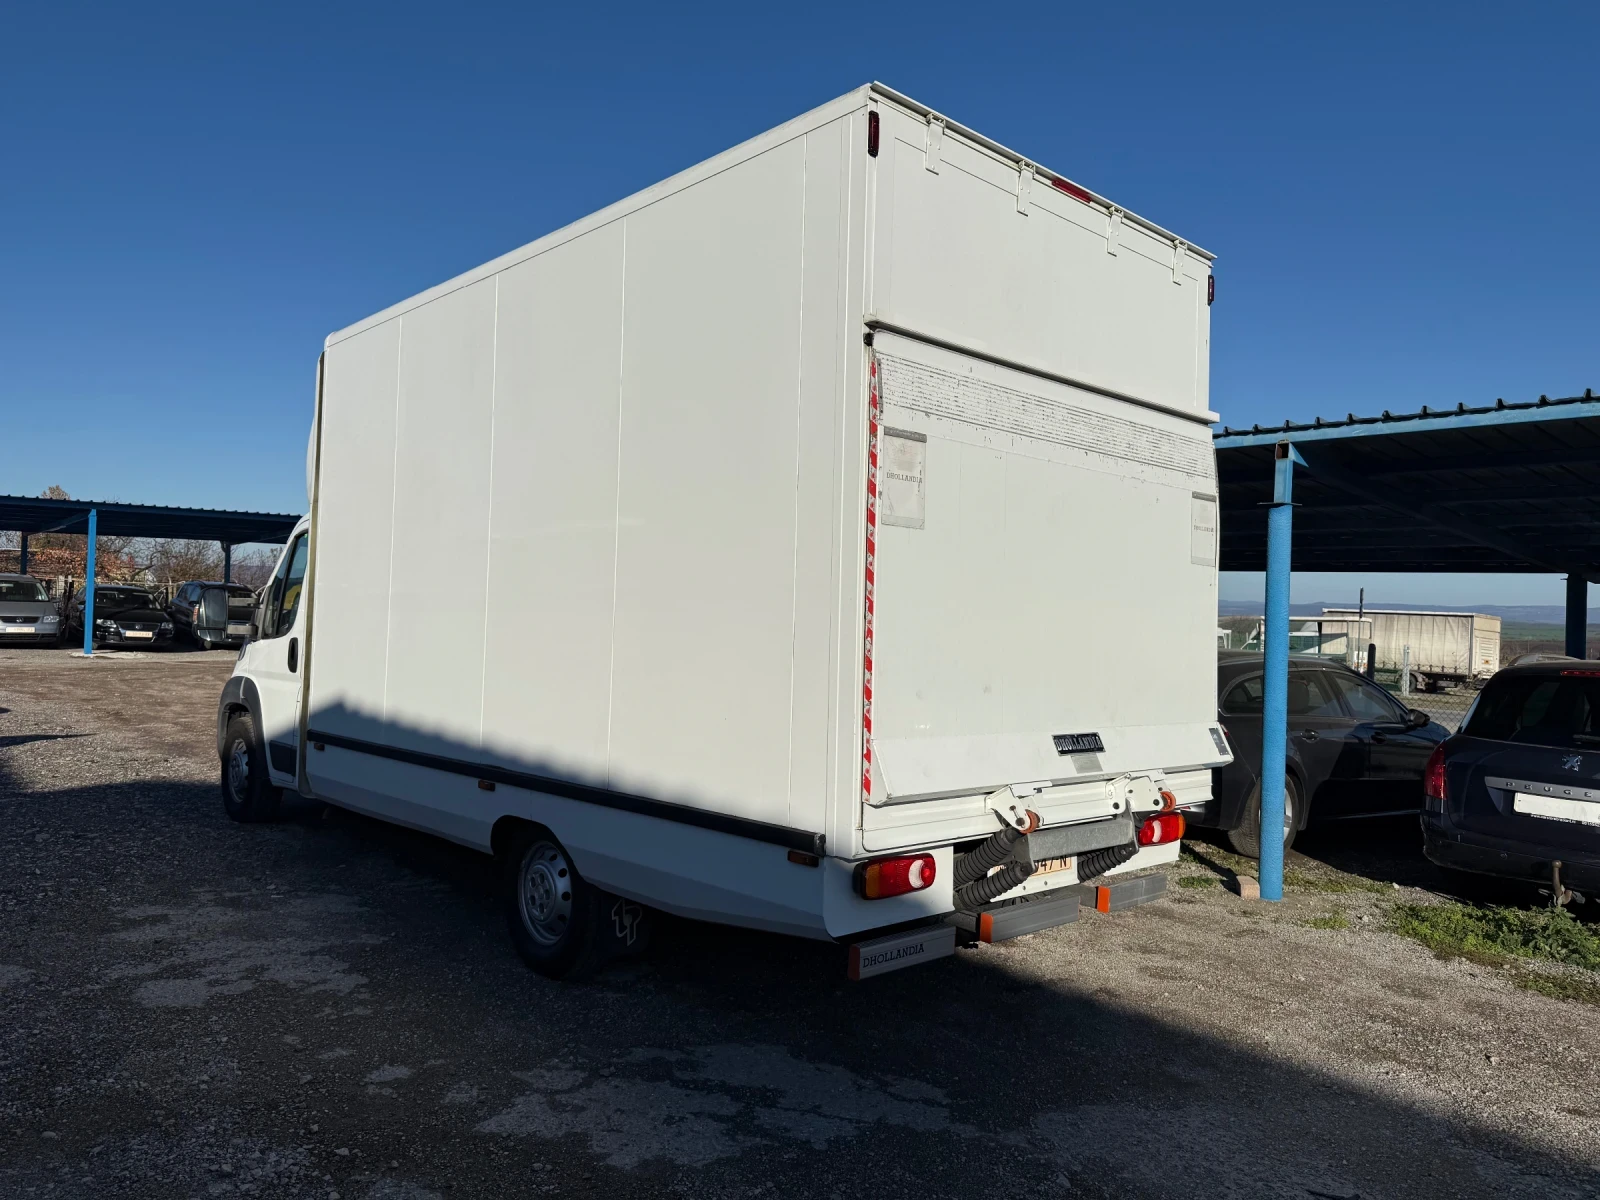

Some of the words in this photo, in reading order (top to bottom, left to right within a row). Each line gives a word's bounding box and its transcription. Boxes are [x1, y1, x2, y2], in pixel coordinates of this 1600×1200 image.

[886, 471, 923, 484] DHOLLANDIA
[1055, 736, 1103, 751] DHOLLANDIA
[863, 943, 925, 968] DHOLLANDIA
